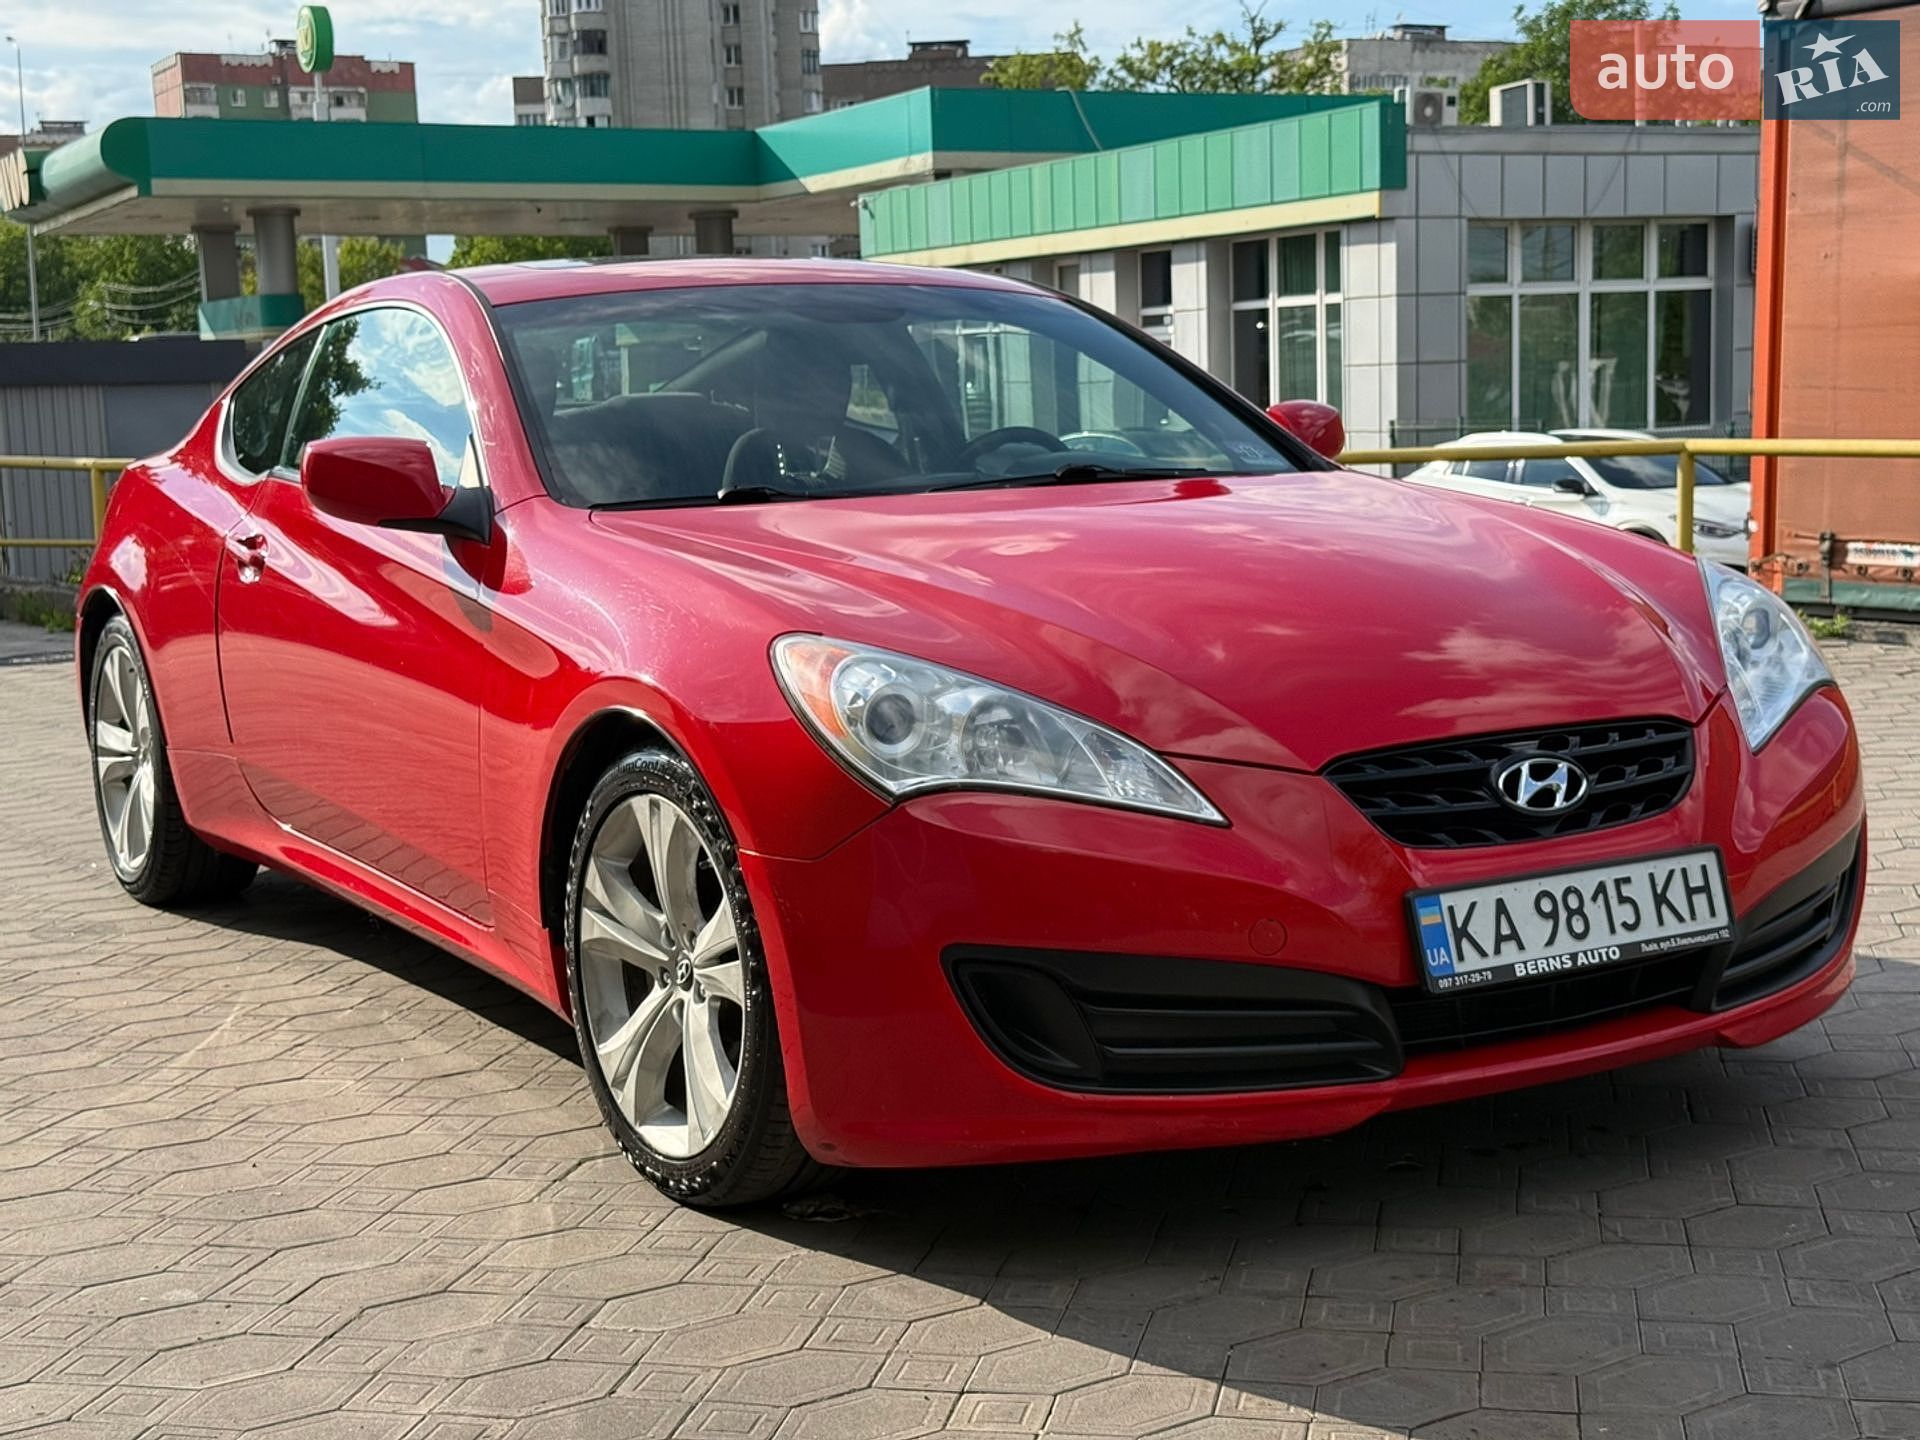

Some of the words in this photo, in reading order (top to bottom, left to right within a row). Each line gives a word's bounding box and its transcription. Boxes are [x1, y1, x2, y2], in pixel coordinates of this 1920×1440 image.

[1447, 897, 1526, 963] KA
[1533, 875, 1642, 948] 9815
[1648, 863, 1718, 927] KH
[1426, 947, 1450, 967] UA
[1513, 953, 1574, 979] BERNS
[1577, 946, 1621, 966] AUTO
